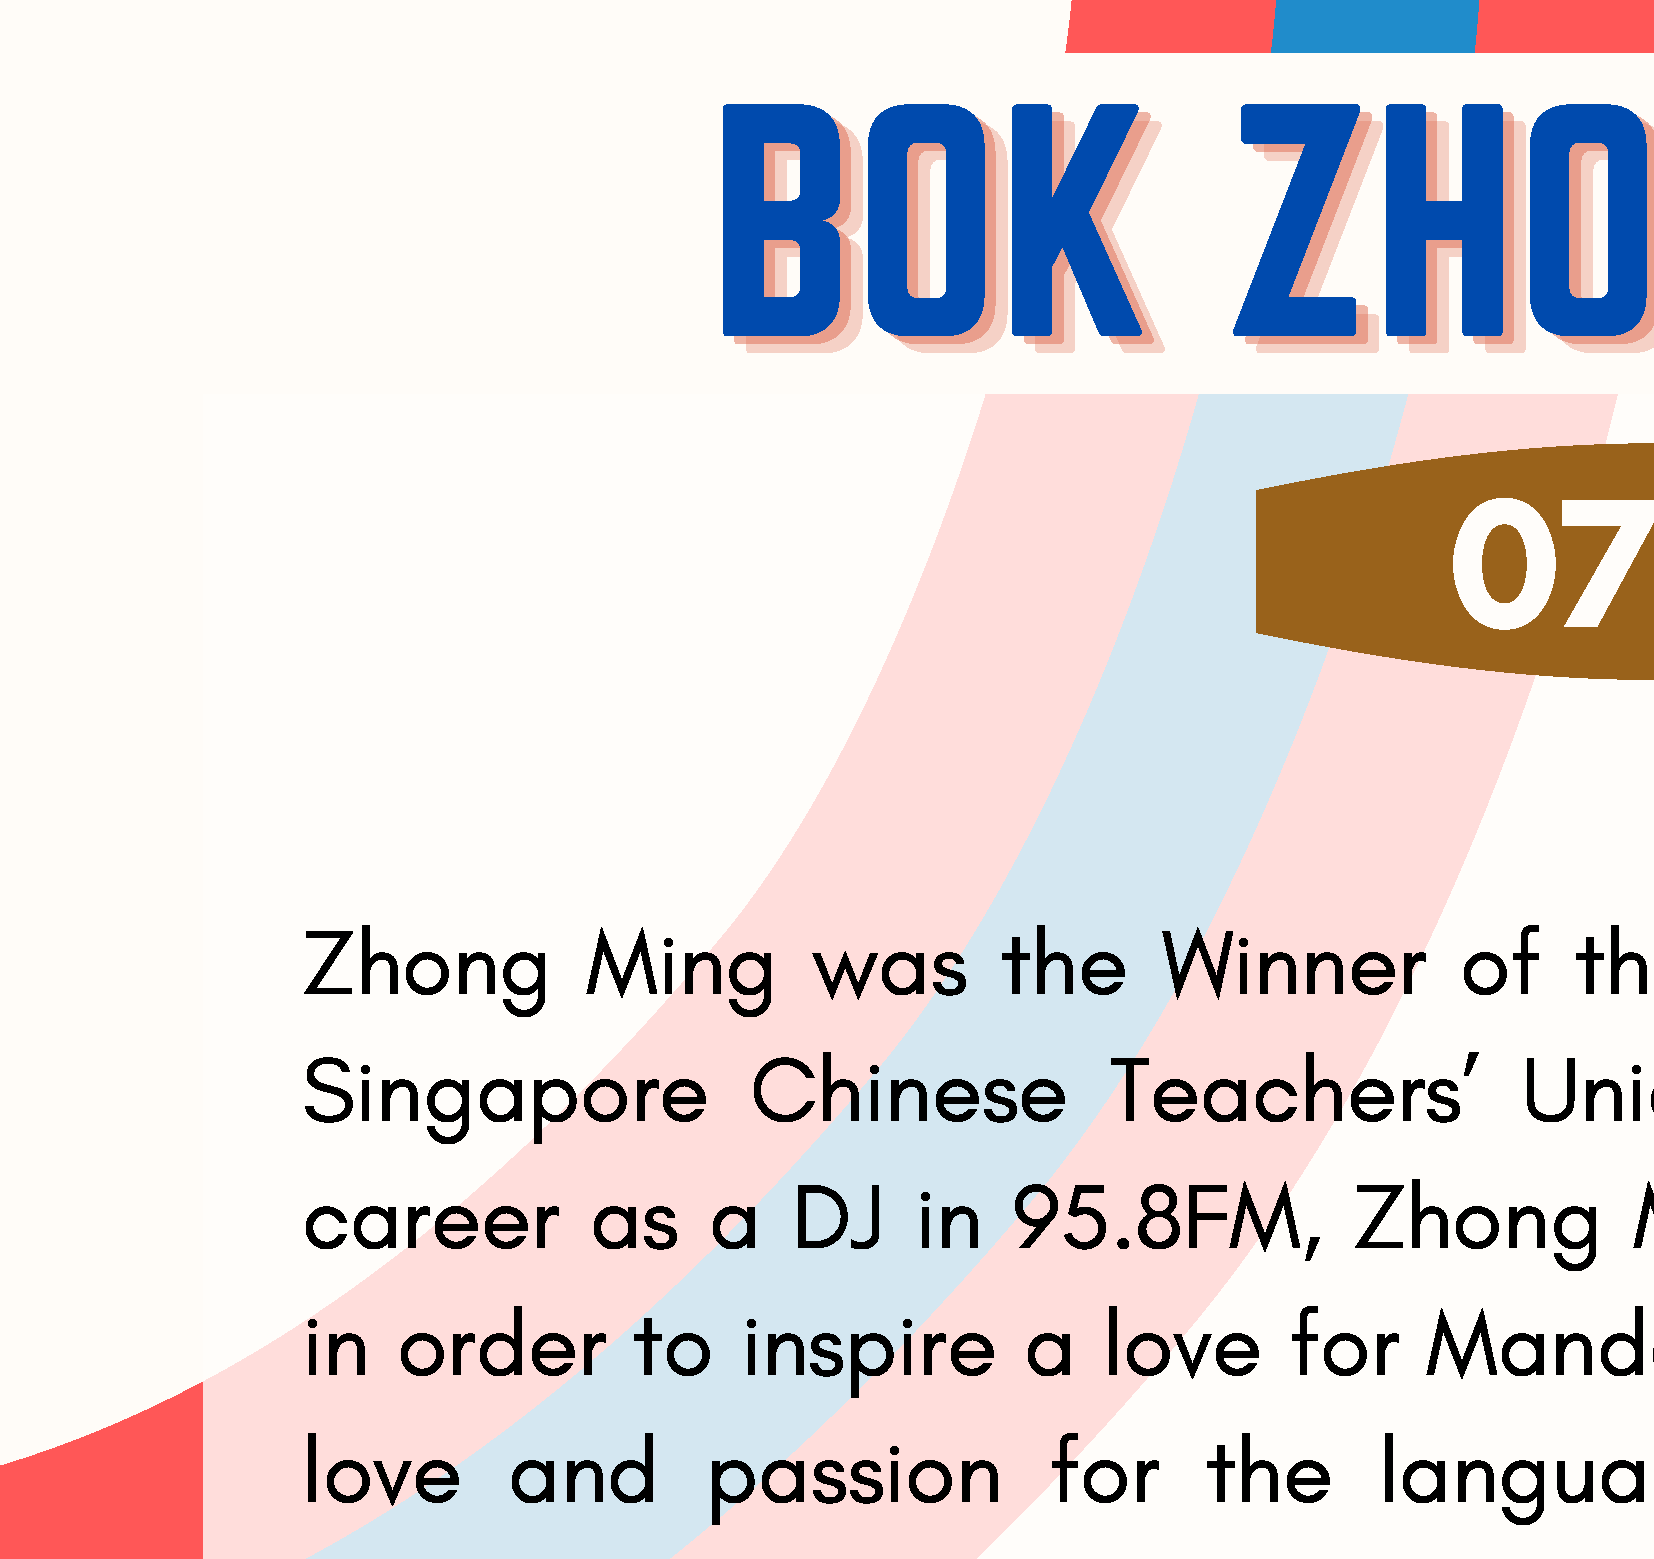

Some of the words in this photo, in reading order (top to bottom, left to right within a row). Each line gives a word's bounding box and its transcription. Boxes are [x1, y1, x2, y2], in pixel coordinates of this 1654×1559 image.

[723, 104, 1142, 336] BOK
[304, 925, 545, 1017] Zhong
[586, 927, 771, 1017] Ming
[812, 951, 966, 1000] was
[1002, 925, 1125, 995] the
[1162, 927, 1426, 1000] Winner
[1464, 925, 1539, 995] of
[305, 1057, 706, 1144] Singapore
[754, 1052, 1065, 1123] Chinese
[306, 1206, 559, 1249] career
[594, 1206, 677, 1250] as
[713, 1206, 755, 1249] a
[798, 1185, 879, 1249] DJ
[921, 1192, 978, 1248] in
[1015, 1181, 1320, 1261] 95.8FM,
[1355, 1179, 1596, 1271] Zhong
[308, 1319, 365, 1375] in
[401, 1306, 606, 1376] order
[634, 1318, 710, 1376] to
[747, 1319, 994, 1398] inspire
[1028, 1333, 1070, 1376] a
[1109, 1306, 1259, 1379] love
[1292, 1306, 1399, 1376] for
[308, 1433, 459, 1506] love
[512, 1433, 653, 1503] and
[712, 1446, 998, 1525] passion
[1052, 1433, 1159, 1503] for
[1207, 1433, 1330, 1503] the
